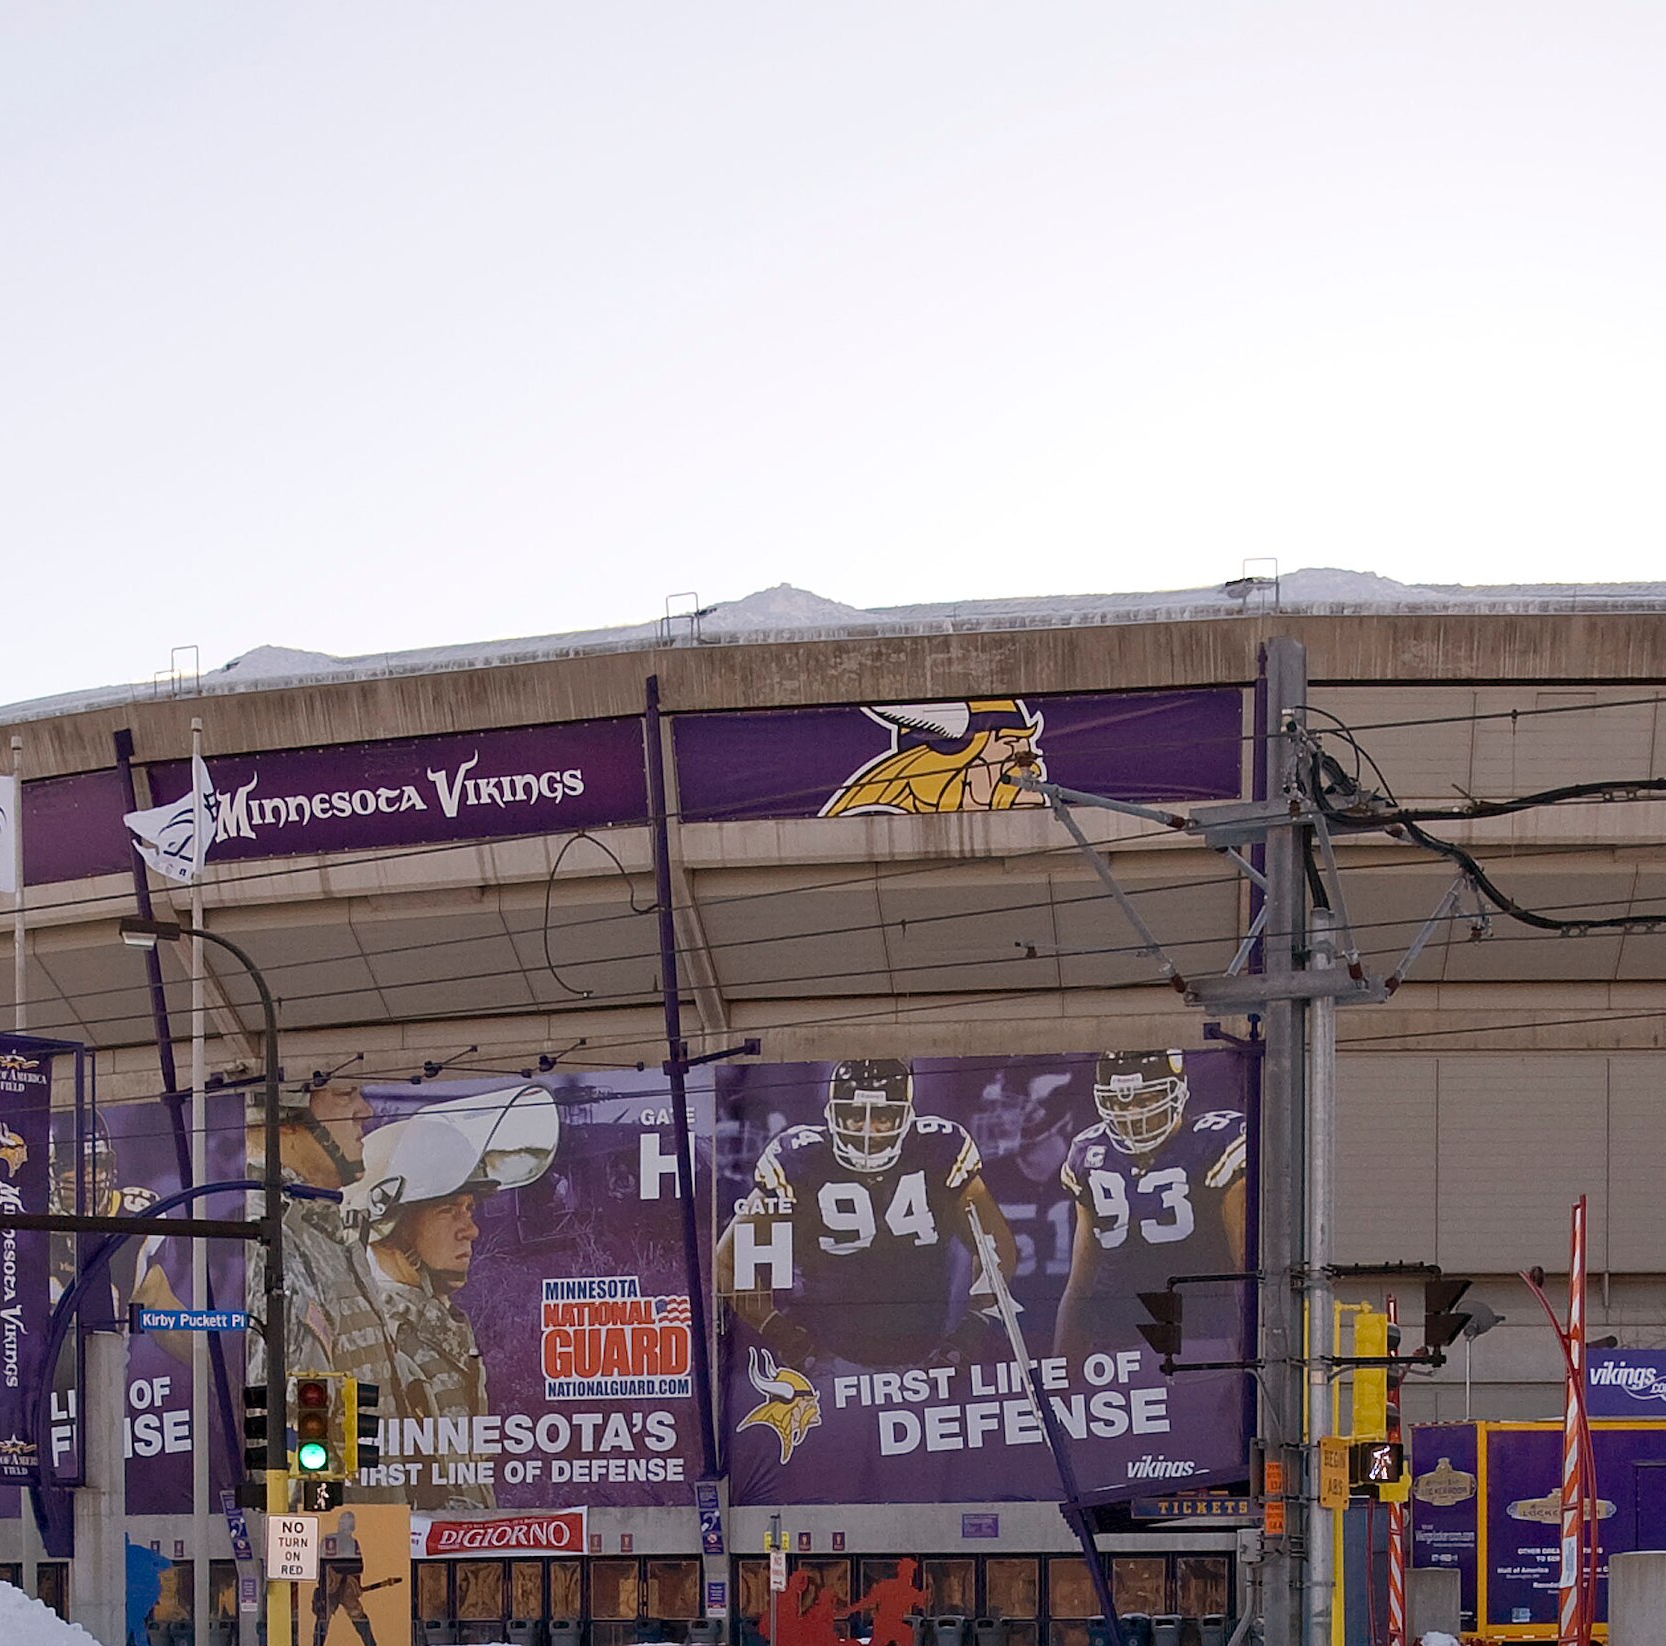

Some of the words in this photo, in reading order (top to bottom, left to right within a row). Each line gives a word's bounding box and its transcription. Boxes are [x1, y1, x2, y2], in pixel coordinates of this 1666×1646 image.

[734, 1197, 793, 1215] GATE
[818, 1169, 939, 1256] 94
[1088, 1166, 1195, 1249] 93
[734, 1222, 793, 1290] H
[544, 1279, 639, 1300] MINNESOTA
[142, 1314, 176, 1330] Kirby
[179, 1313, 229, 1328] Puckett
[543, 1300, 656, 1327] NATIONAL
[544, 1326, 689, 1379] GUARD
[547, 1379, 690, 1398] NATIONALGUARD.COM
[834, 1366, 956, 1409] FIRST
[1083, 1350, 1142, 1387] OF
[129, 1377, 172, 1410] OF
[877, 1386, 1171, 1456] DEFENSE
[345, 1463, 423, 1487] IRST
[432, 1462, 495, 1485] LINE
[504, 1460, 543, 1484] OF
[551, 1457, 684, 1483] DEFENSE
[1157, 1500, 1249, 1515] TICKETS
[282, 1521, 304, 1534] NO
[278, 1536, 308, 1548] TURN
[285, 1551, 301, 1561] ON
[281, 1564, 304, 1575] RED
